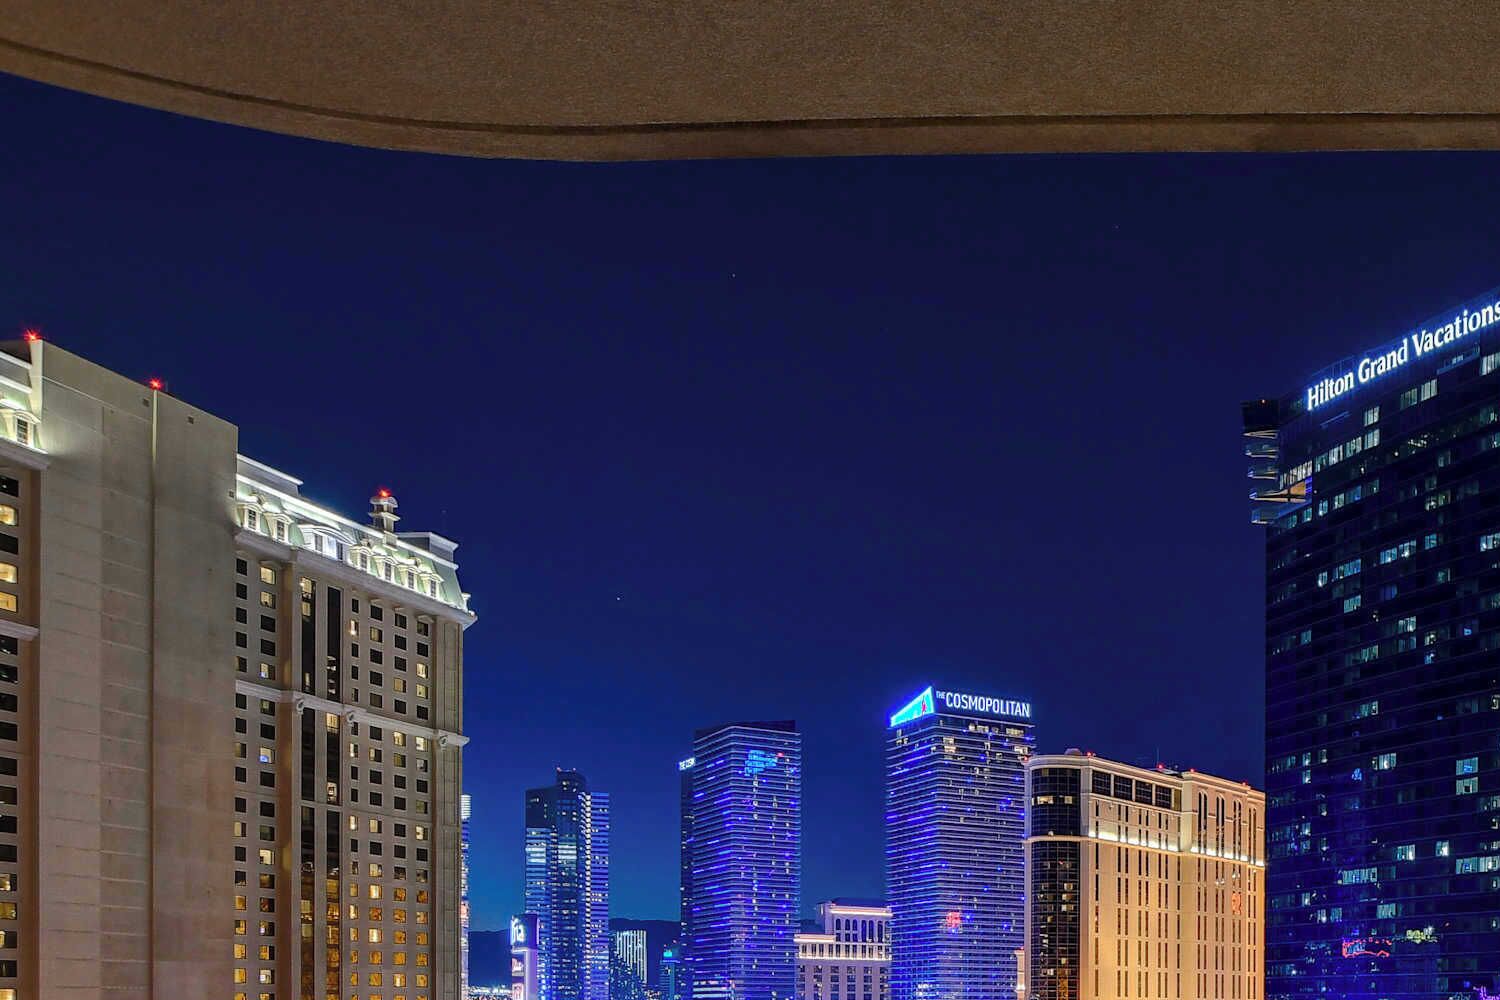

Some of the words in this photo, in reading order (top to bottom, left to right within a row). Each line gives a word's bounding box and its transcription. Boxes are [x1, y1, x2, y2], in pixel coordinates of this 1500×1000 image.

[1308, 372, 1354, 411] Hilton
[1357, 338, 1408, 383] Grand
[936, 690, 946, 699] THE
[946, 692, 1030, 718] COSMOPOLITAN
